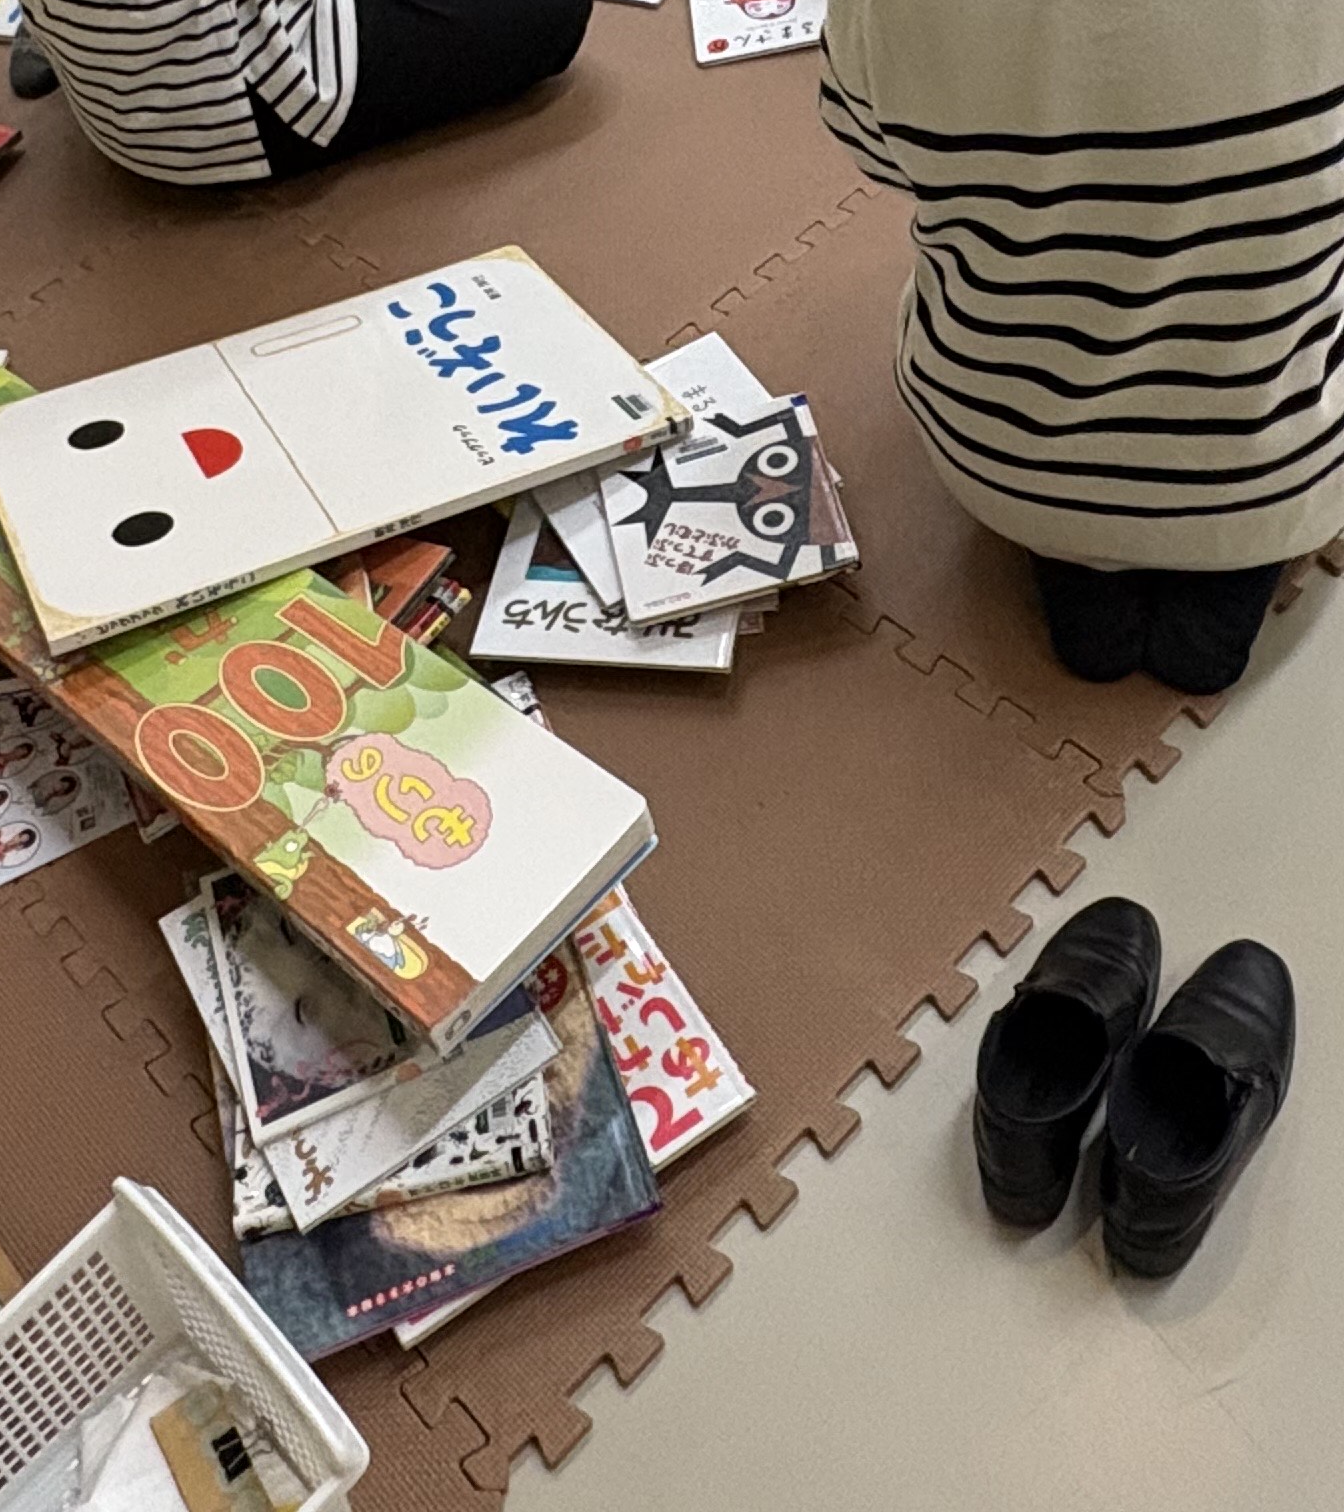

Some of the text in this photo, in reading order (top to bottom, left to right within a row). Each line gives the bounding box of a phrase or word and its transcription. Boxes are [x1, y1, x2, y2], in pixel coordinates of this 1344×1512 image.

[387, 281, 579, 455] れいぞうこ
[644, 551, 695, 576] ほっぷ
[652, 536, 716, 562] すてっぷ
[663, 521, 742, 551] かぶとむし
[341, 744, 473, 849] もりの
[577, 921, 724, 1098] あしがた
